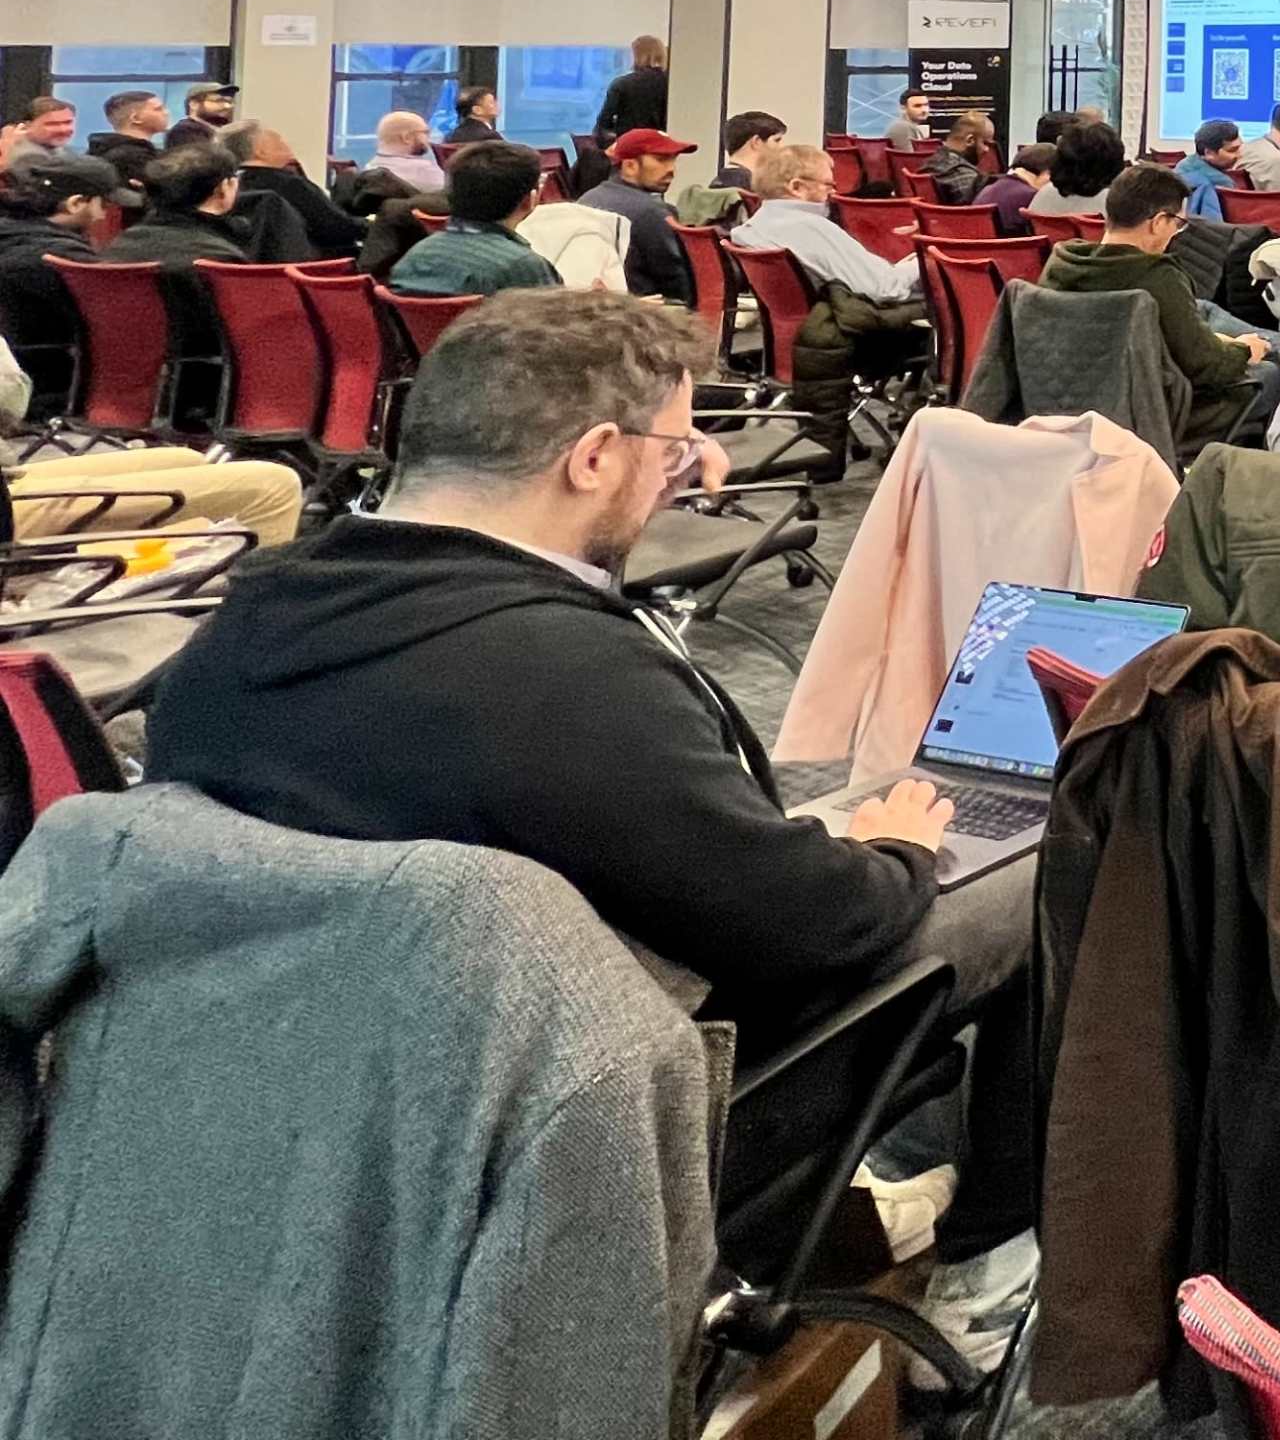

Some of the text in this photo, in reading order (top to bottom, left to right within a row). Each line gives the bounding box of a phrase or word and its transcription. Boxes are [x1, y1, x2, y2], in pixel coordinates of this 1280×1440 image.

[921, 61, 972, 70] Your Data
[921, 71, 978, 81] Operations
[921, 82, 953, 91] Cloud
